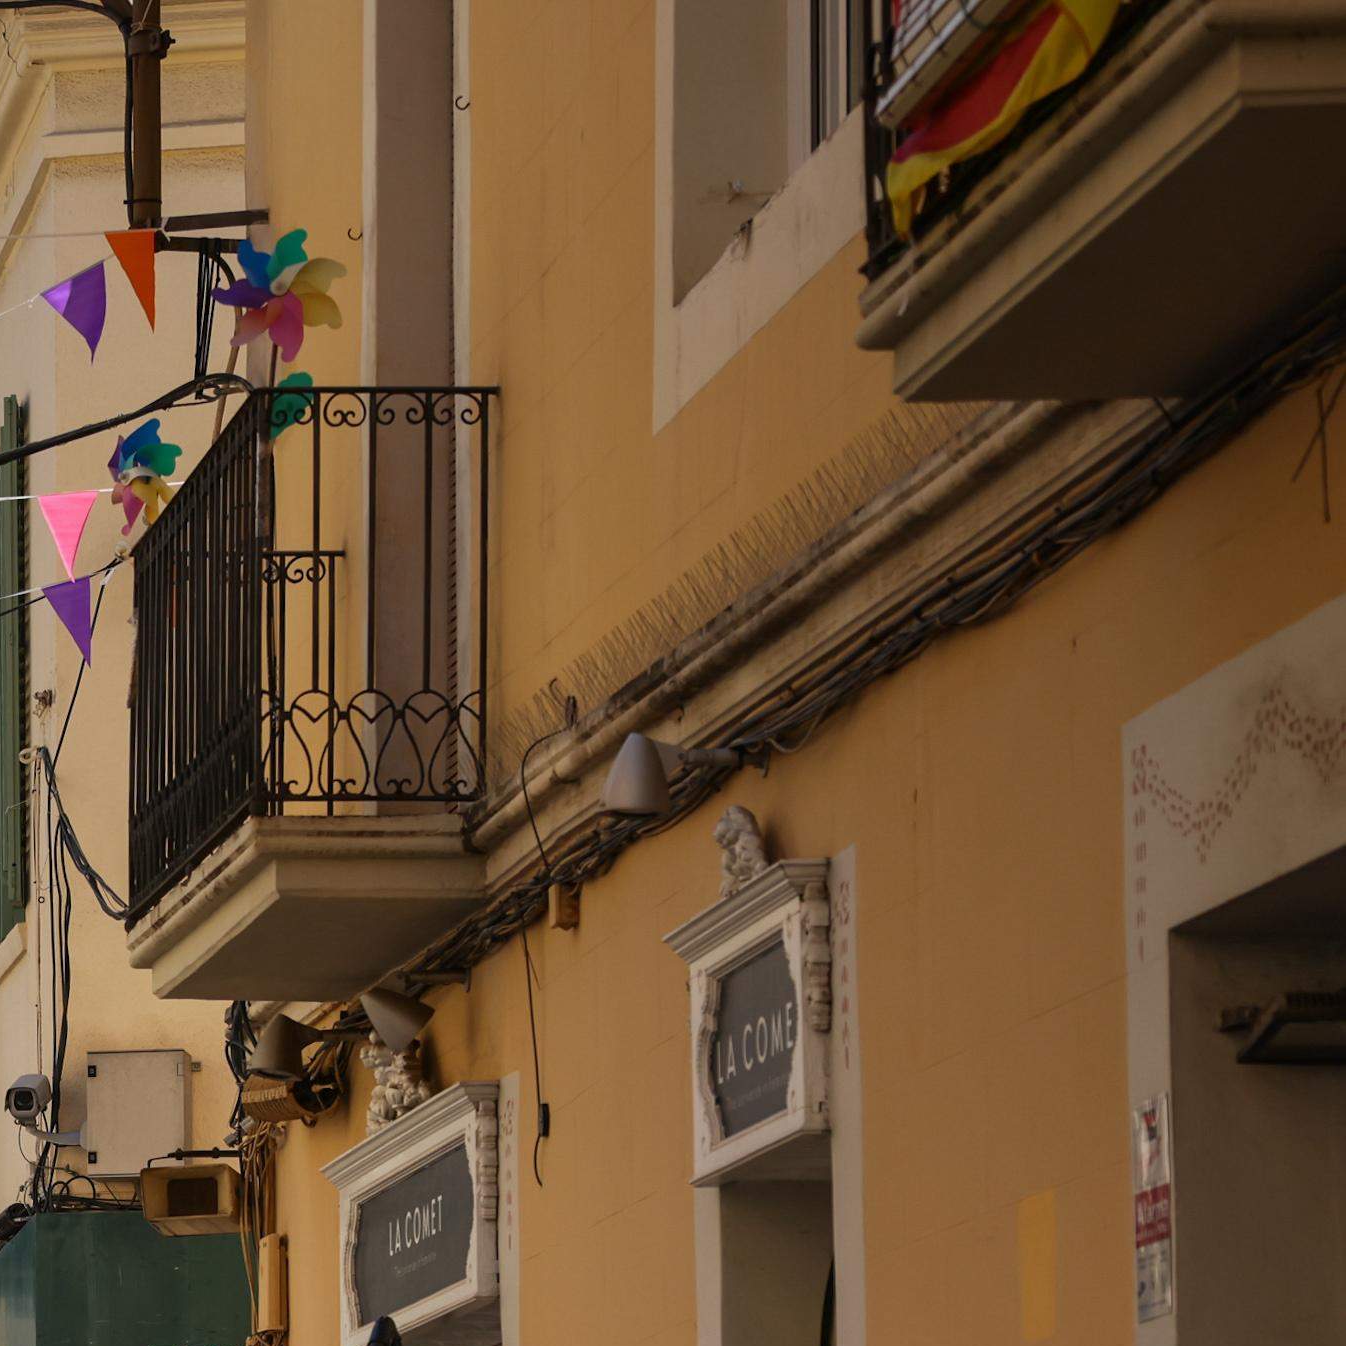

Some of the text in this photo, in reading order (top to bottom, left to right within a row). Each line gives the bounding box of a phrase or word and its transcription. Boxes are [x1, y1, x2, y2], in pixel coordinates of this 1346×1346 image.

[716, 1034, 737, 1084] LA
[389, 1195, 443, 1256] LA COMET
